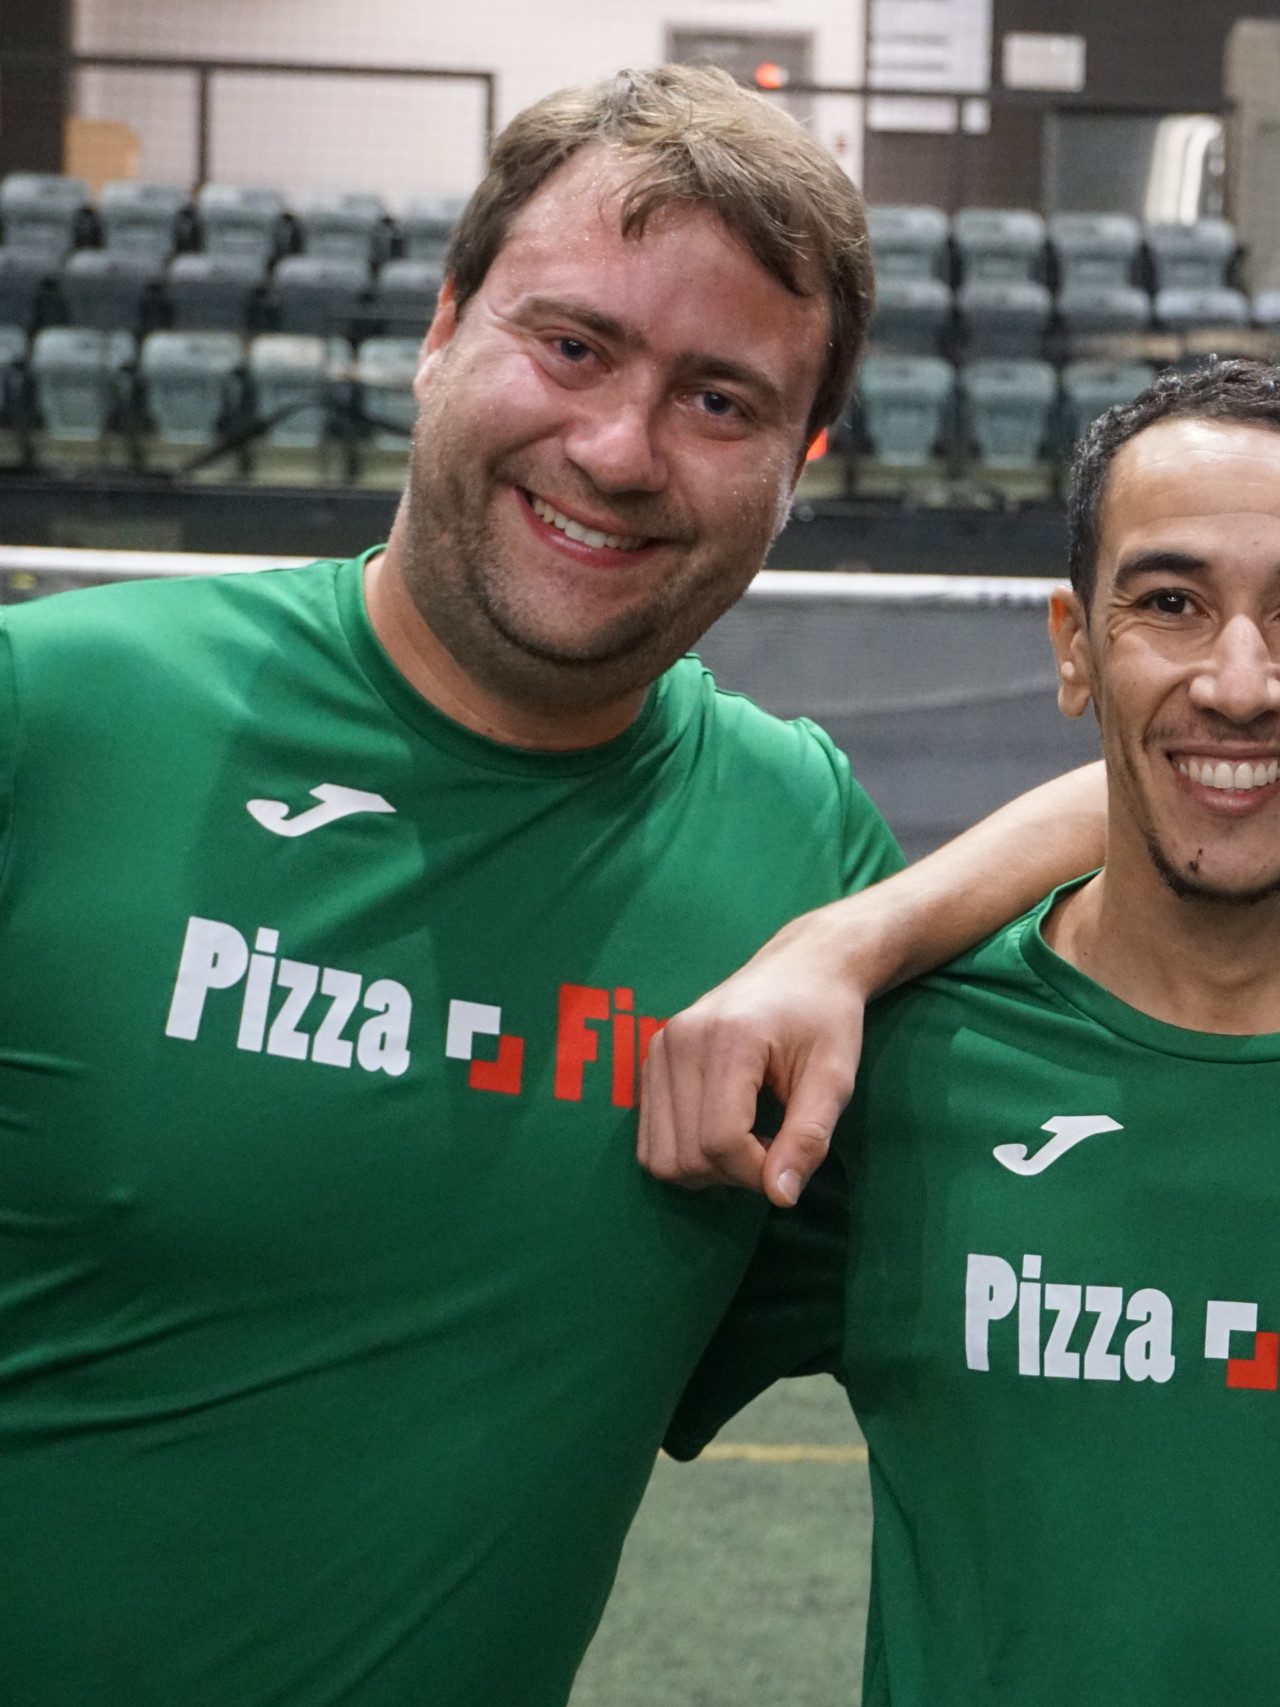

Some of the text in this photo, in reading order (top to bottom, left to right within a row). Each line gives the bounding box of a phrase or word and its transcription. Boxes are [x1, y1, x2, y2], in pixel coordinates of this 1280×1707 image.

[165, 916, 669, 1109] Pizza Fi
[965, 1253, 1176, 1383] Pizza
